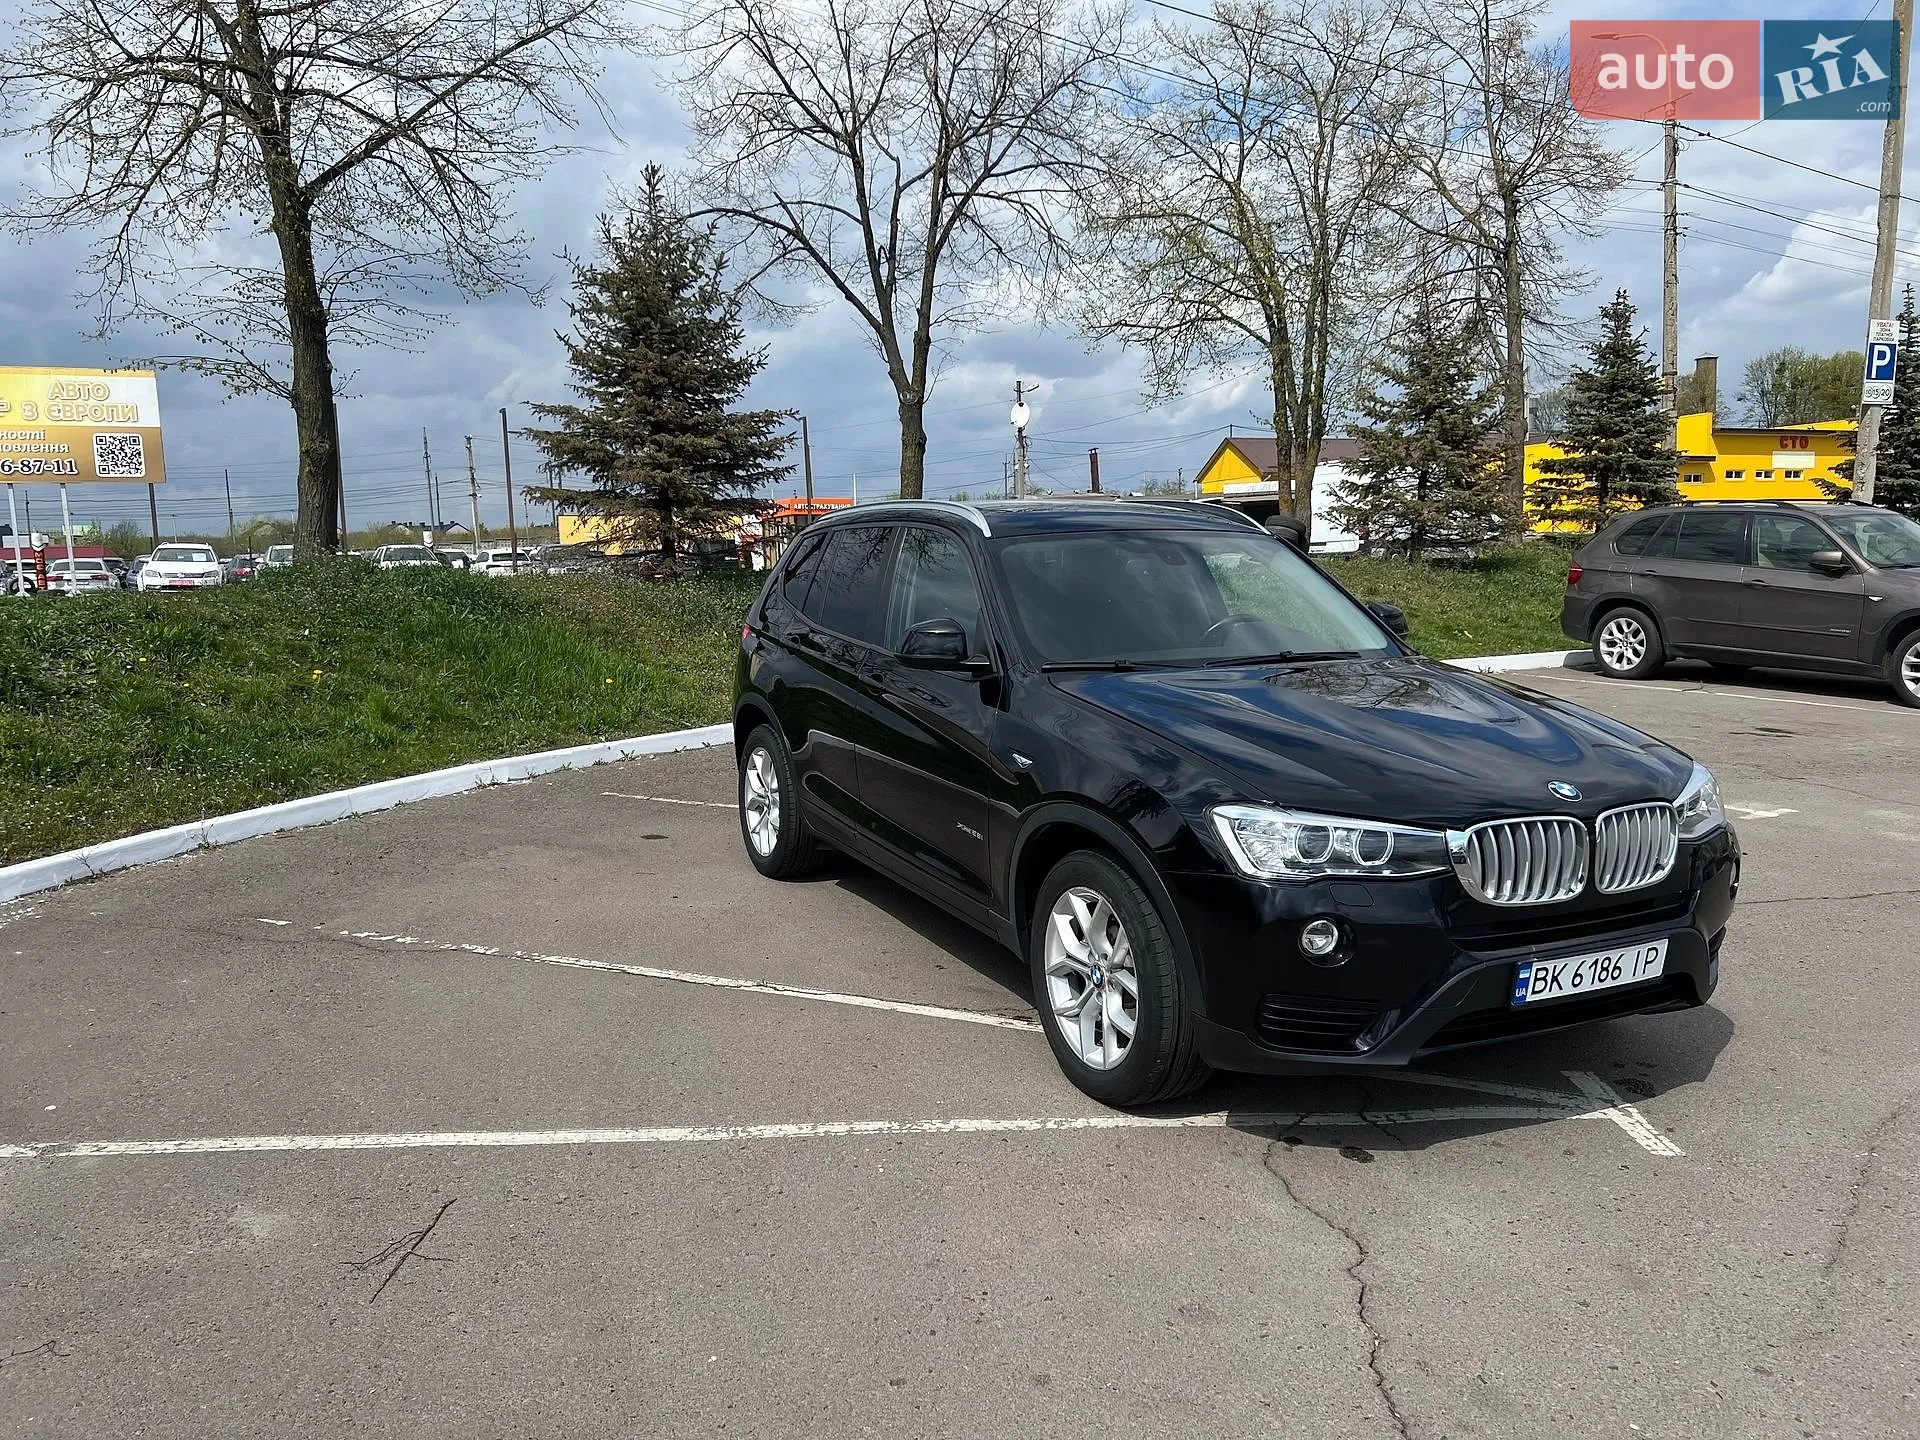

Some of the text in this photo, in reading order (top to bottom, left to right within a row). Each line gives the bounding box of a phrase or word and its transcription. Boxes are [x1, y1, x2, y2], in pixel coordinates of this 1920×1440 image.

[1871, 344, 1891, 379] P
[48, 380, 110, 401] АВТО
[45, 402, 139, 422] ЄВРОПИ
[1779, 435, 1810, 449] СТО
[0, 458, 78, 475] 6-87-11
[1515, 946, 1659, 998] UA BK 6186 IP
